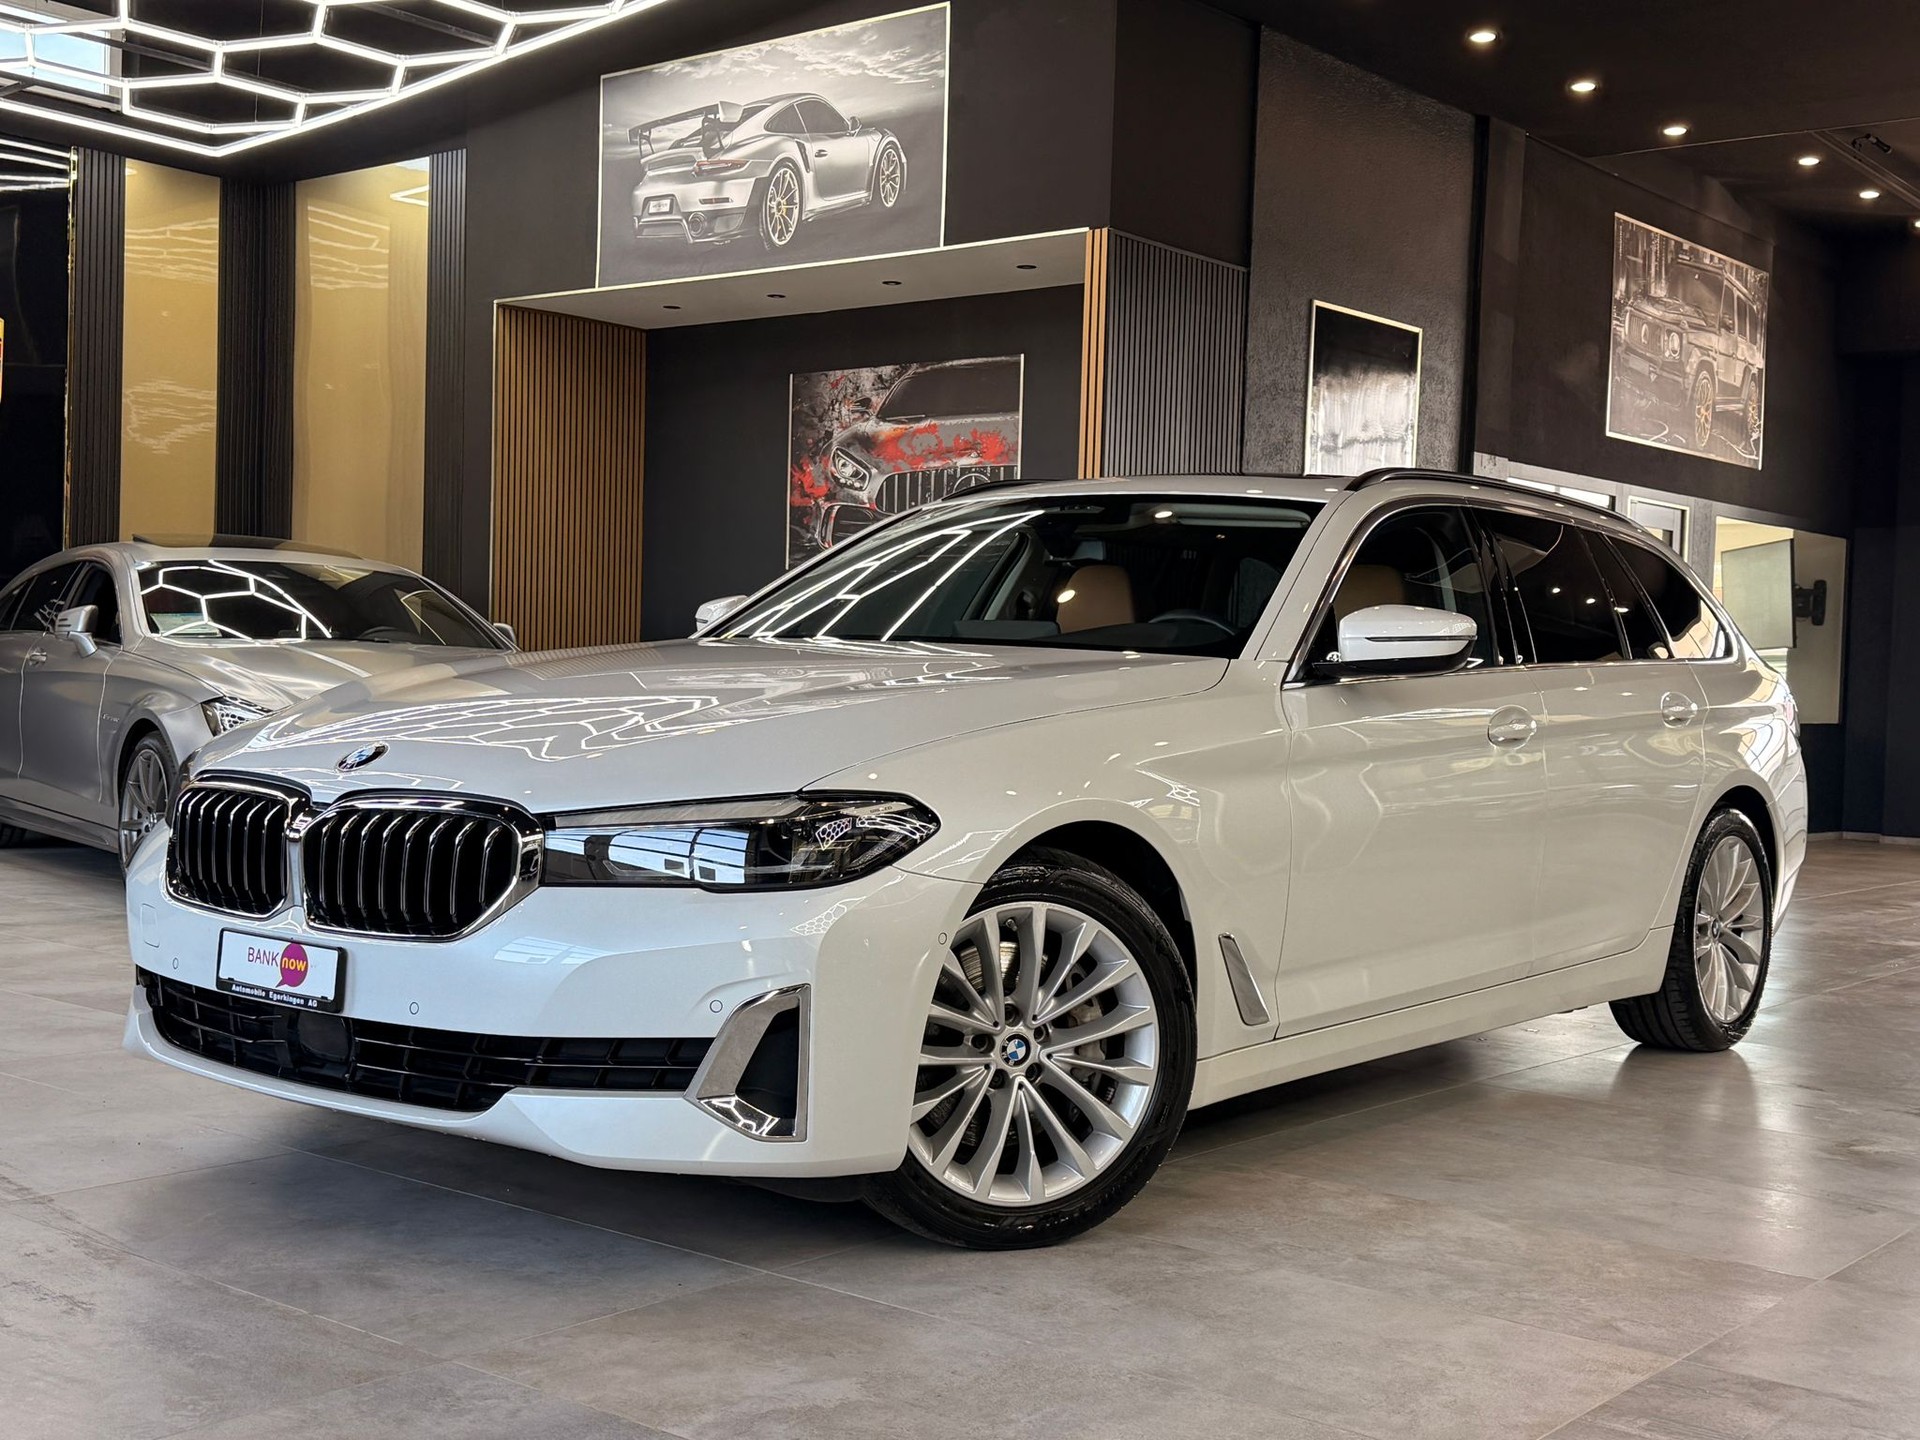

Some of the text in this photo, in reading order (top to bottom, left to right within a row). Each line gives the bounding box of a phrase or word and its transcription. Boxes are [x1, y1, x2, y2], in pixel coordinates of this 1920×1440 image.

[247, 946, 307, 972] BANK now
[231, 984, 318, 1008] Automobile Egerkingen AG
